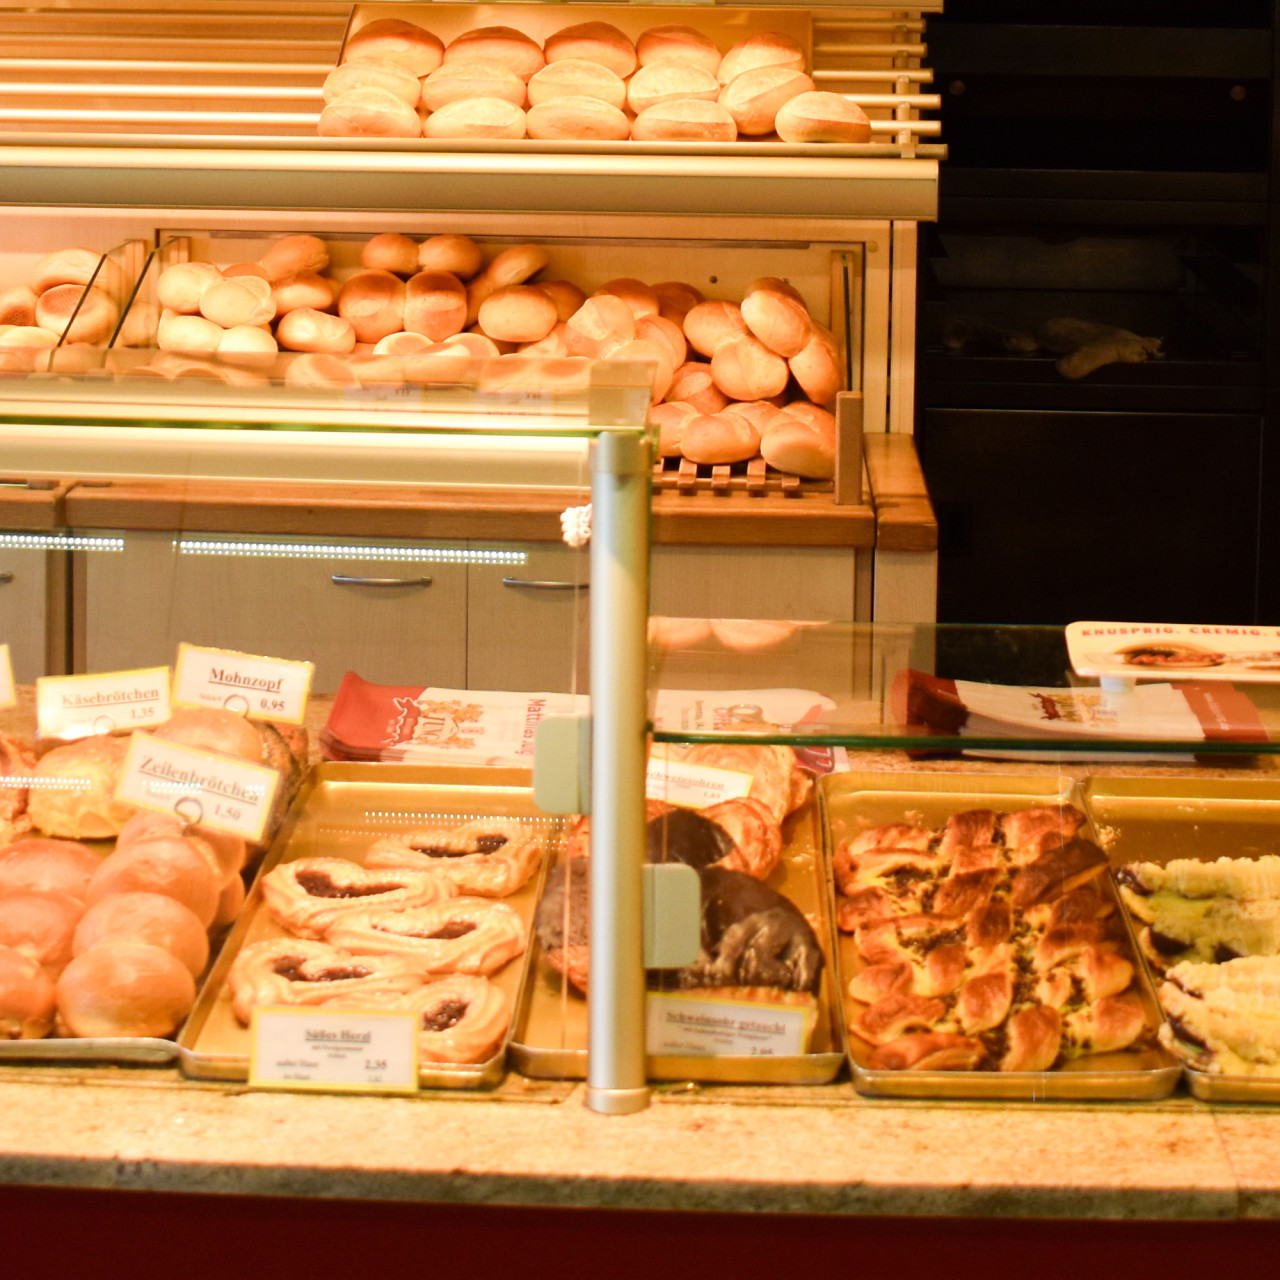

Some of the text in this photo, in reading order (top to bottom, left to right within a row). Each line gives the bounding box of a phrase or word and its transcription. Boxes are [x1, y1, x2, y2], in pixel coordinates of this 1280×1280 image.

[1081, 626, 1181, 637] KNUSPRIG.
[1189, 627, 1268, 637] CREMIG.
[210, 668, 284, 691] Mohnzopf
[62, 688, 159, 706] Käsebrötchen
[260, 698, 285, 711] 0,95
[130, 707, 155, 719] 1,35
[140, 755, 260, 802] Zeilenbrötchen
[214, 804, 242, 821] 1,50
